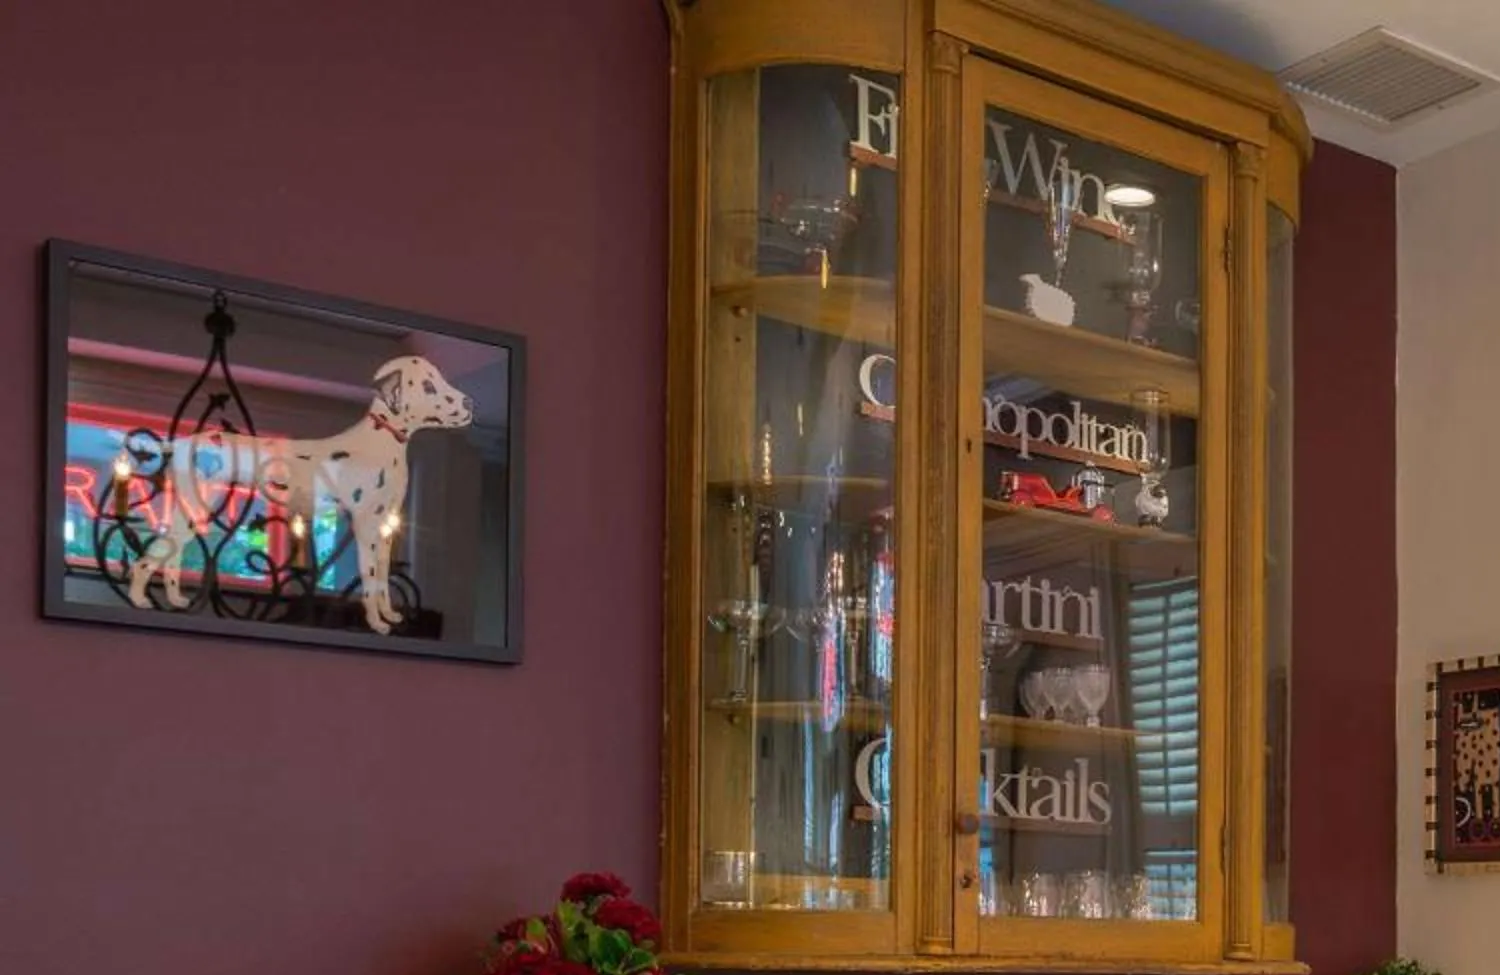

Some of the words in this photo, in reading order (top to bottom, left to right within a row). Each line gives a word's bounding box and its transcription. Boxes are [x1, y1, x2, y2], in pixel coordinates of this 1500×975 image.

[849, 73, 899, 159] Fi
[987, 119, 1130, 228] Win
[855, 737, 1112, 826] Cktails
